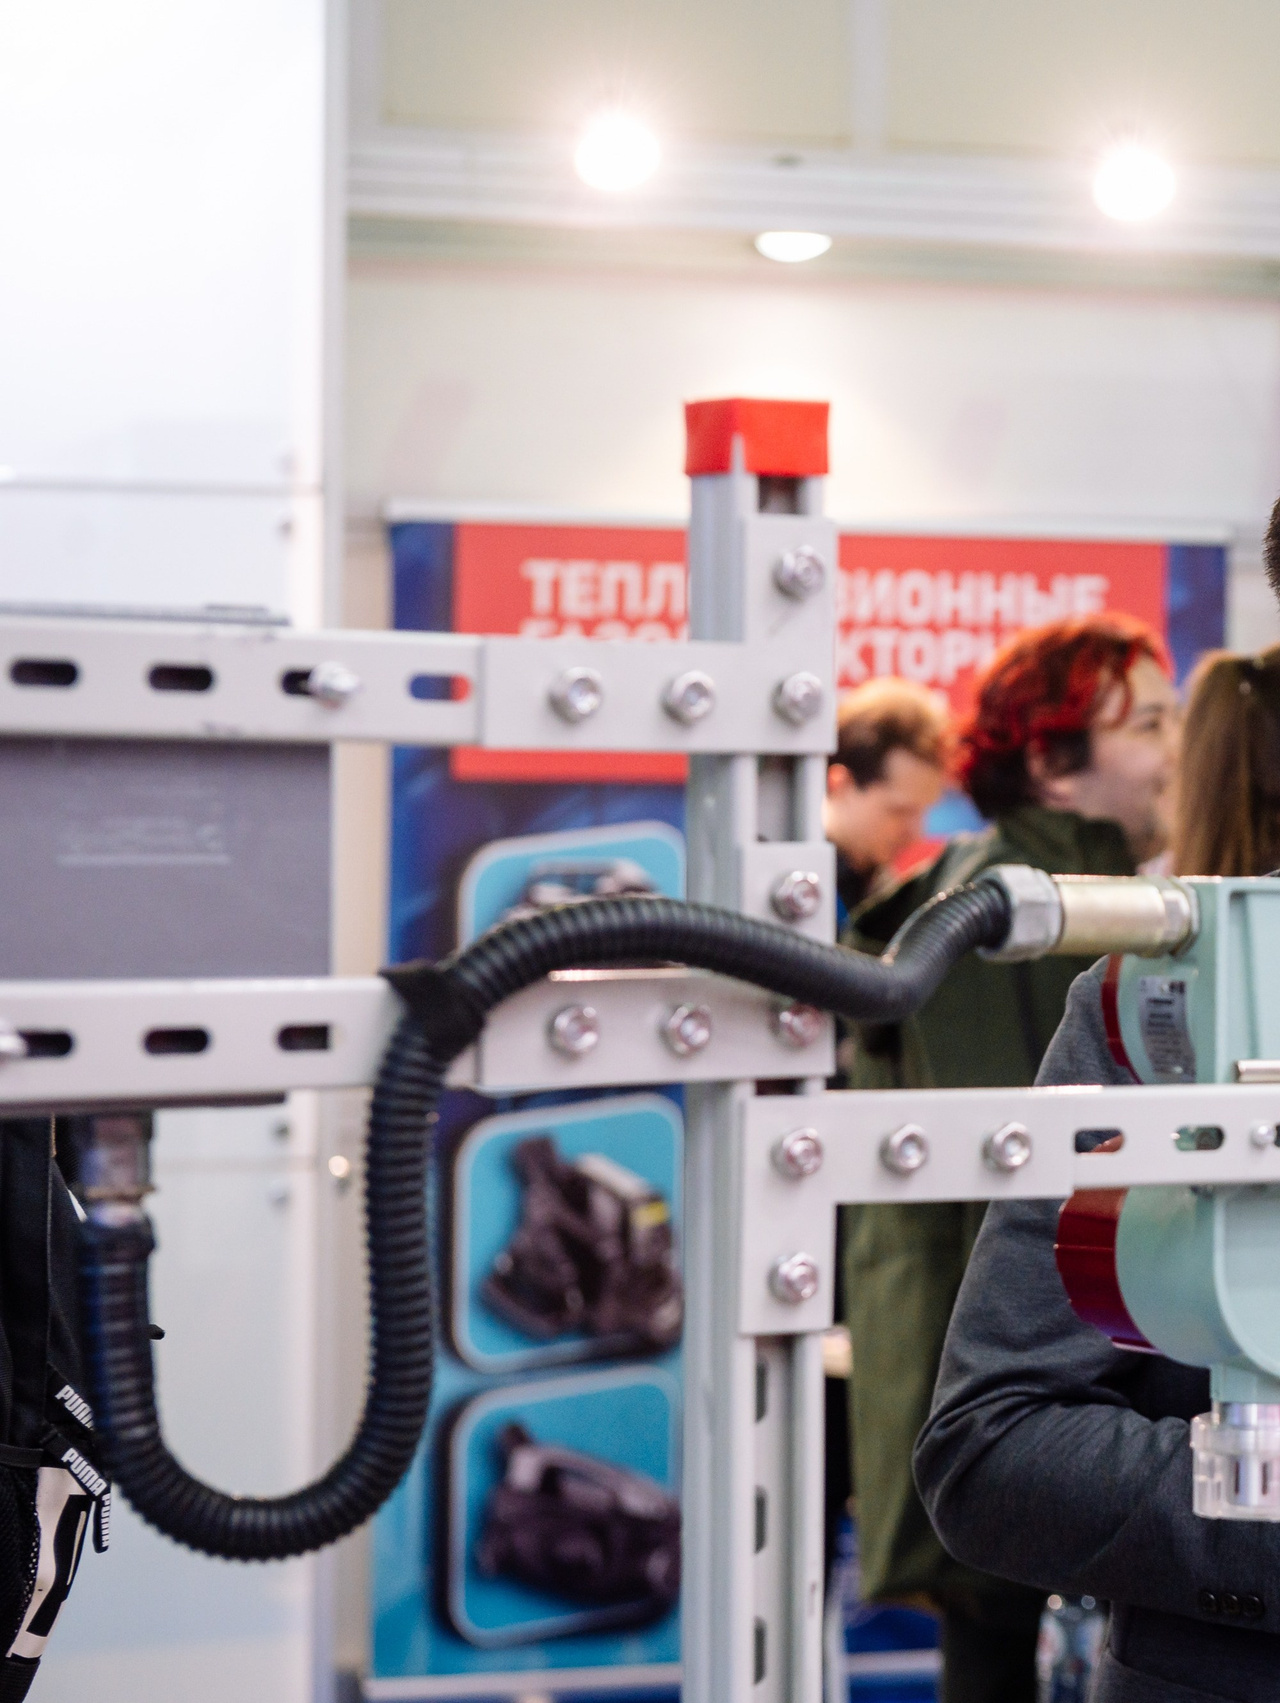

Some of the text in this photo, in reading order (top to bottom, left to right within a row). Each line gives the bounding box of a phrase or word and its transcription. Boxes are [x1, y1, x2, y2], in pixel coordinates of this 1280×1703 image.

[519, 558, 1109, 629] ТЕПЛИОННЫЕ
[55, 1384, 95, 1431] PUM
[61, 1447, 108, 1497] PUMA
[101, 1493, 111, 1548] PUMA
